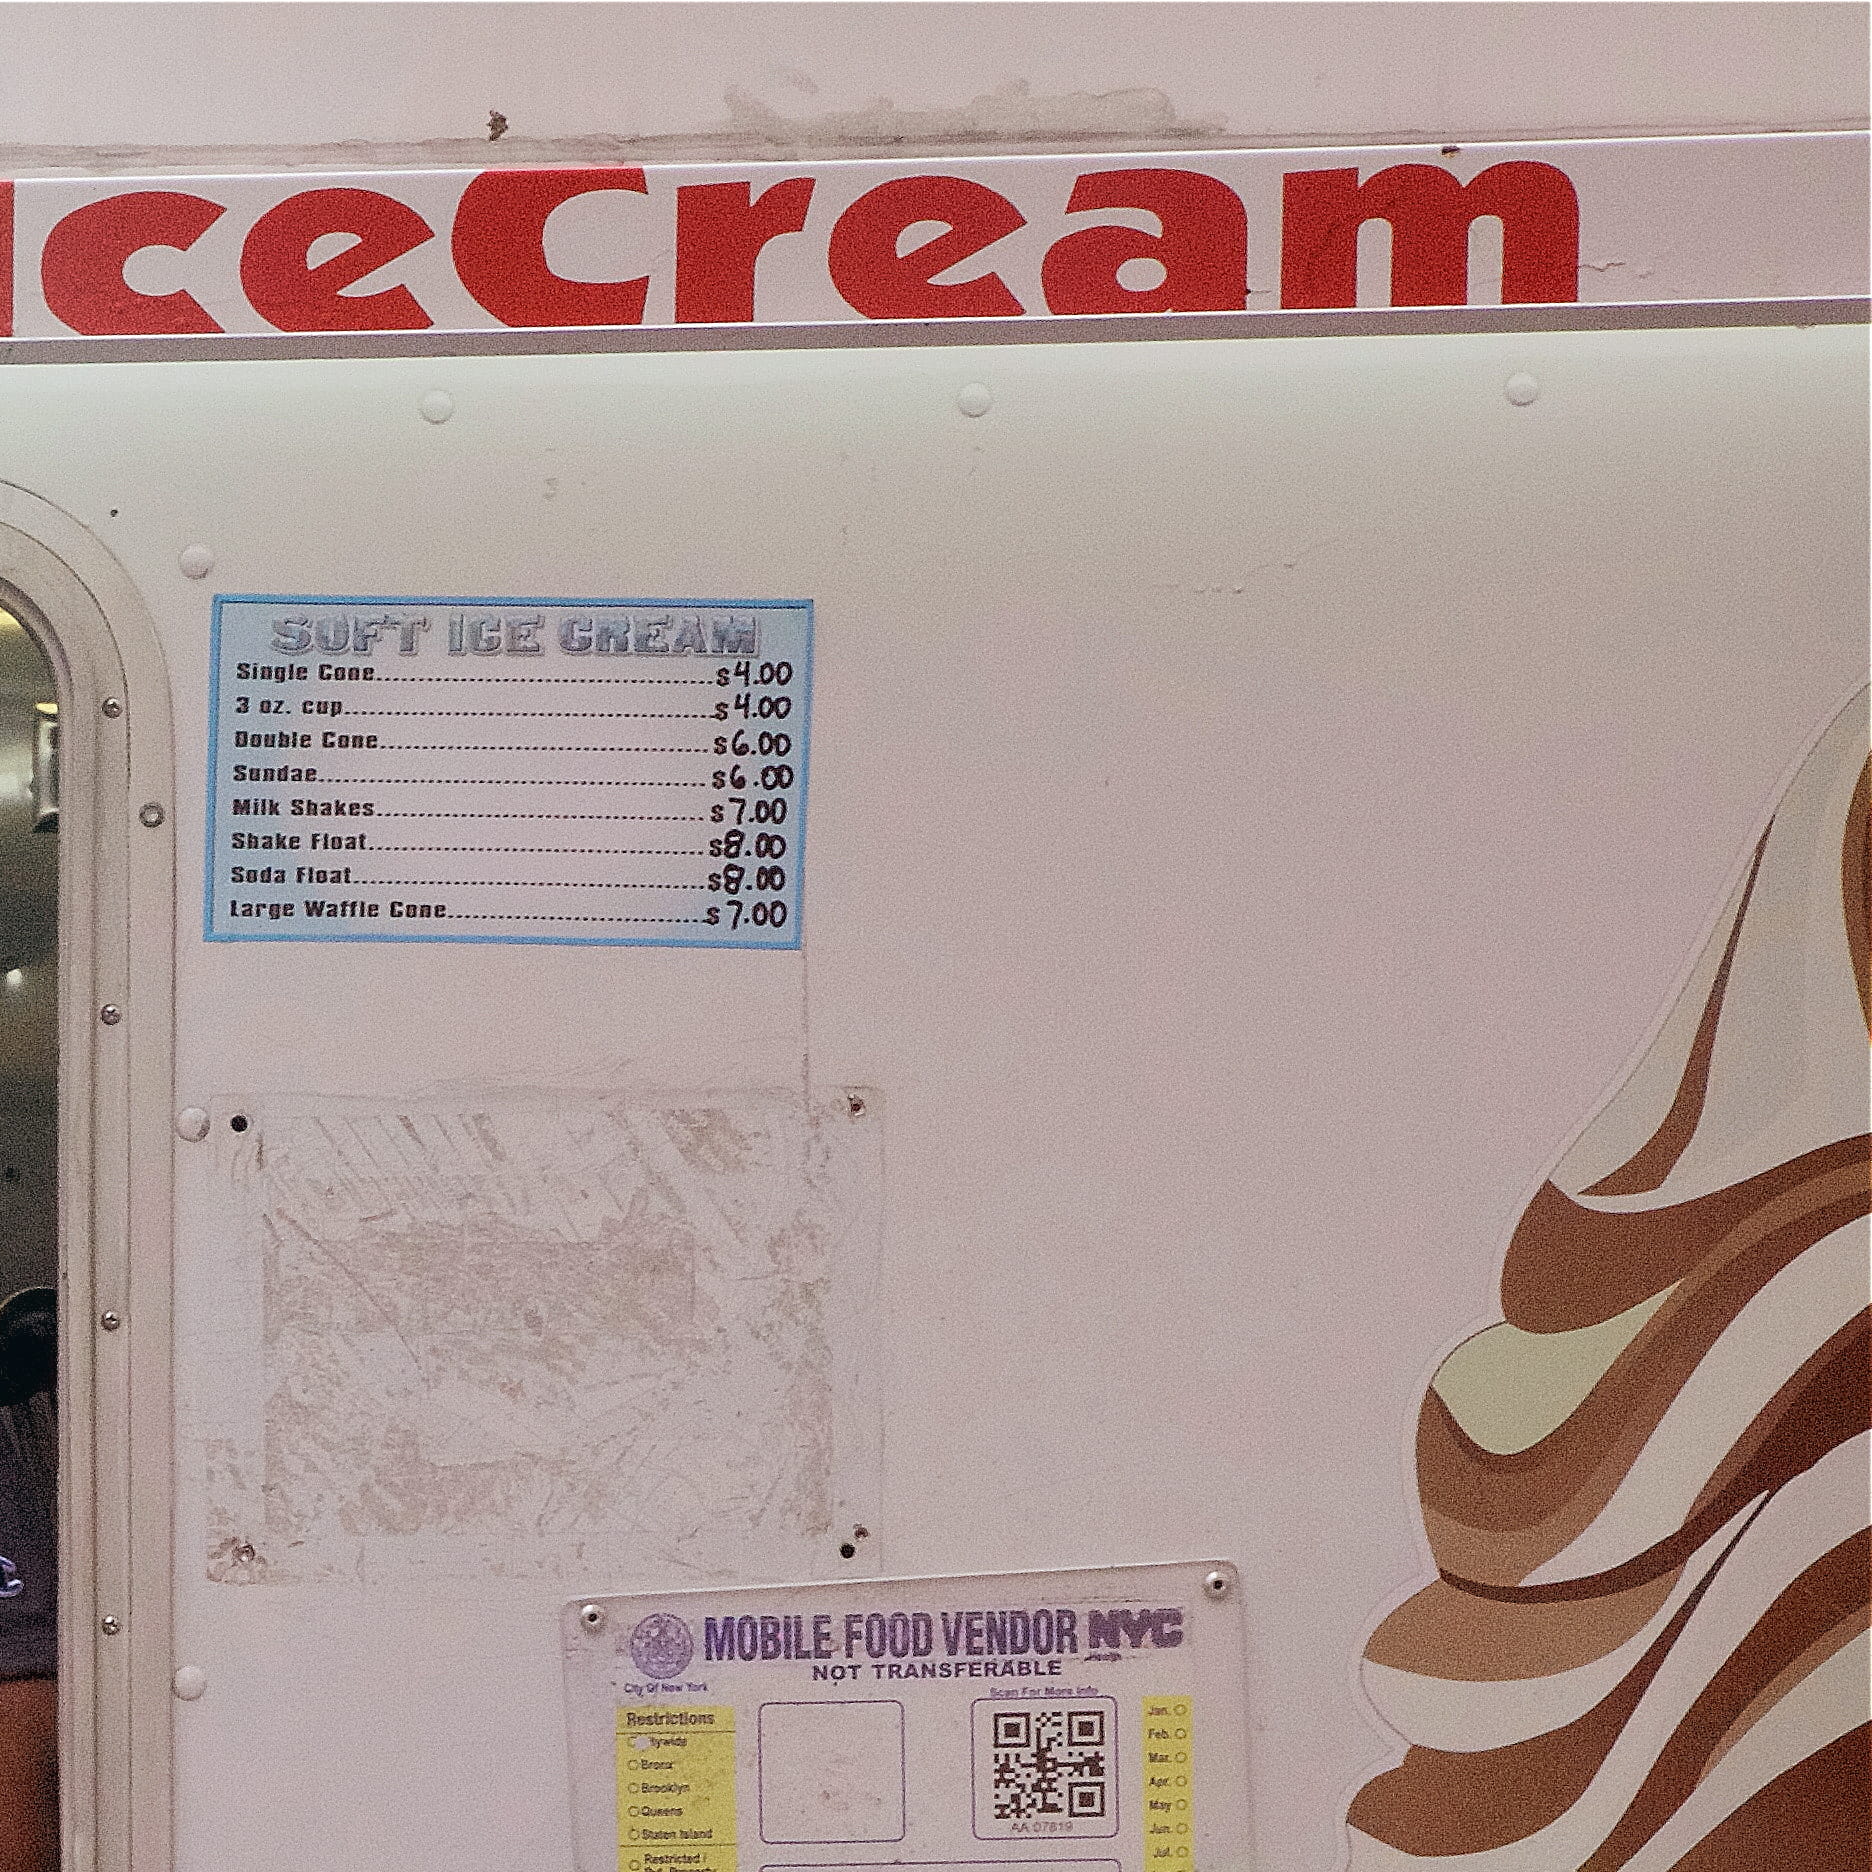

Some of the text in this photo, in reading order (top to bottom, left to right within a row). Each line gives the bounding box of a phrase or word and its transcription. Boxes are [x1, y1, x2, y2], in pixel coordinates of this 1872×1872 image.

[271, 613, 758, 657] SOFT ICE CREAM
[236, 661, 793, 687] Single Cone $4.00
[236, 696, 792, 721] 3 oz. cup $4.00
[235, 730, 792, 757] Double Cone $6.00
[234, 765, 317, 783] Sundae
[233, 798, 786, 824] Milk Shakes $7.00
[232, 830, 785, 859] Shake Float $8.00
[231, 864, 784, 893] Soda Float $8.00
[231, 900, 787, 928] Large Waffle Cone $7.00
[705, 1607, 1184, 1661] MOBILE FOOD VENDOR NYC
[813, 1660, 1062, 1680] NOT TRANSFERABLE
[686, 1682, 709, 1693] York
[627, 1712, 716, 1726] Restrictions
[642, 1783, 690, 1795] Brooklyn
[1011, 1822, 1074, 1832] AA 07819
